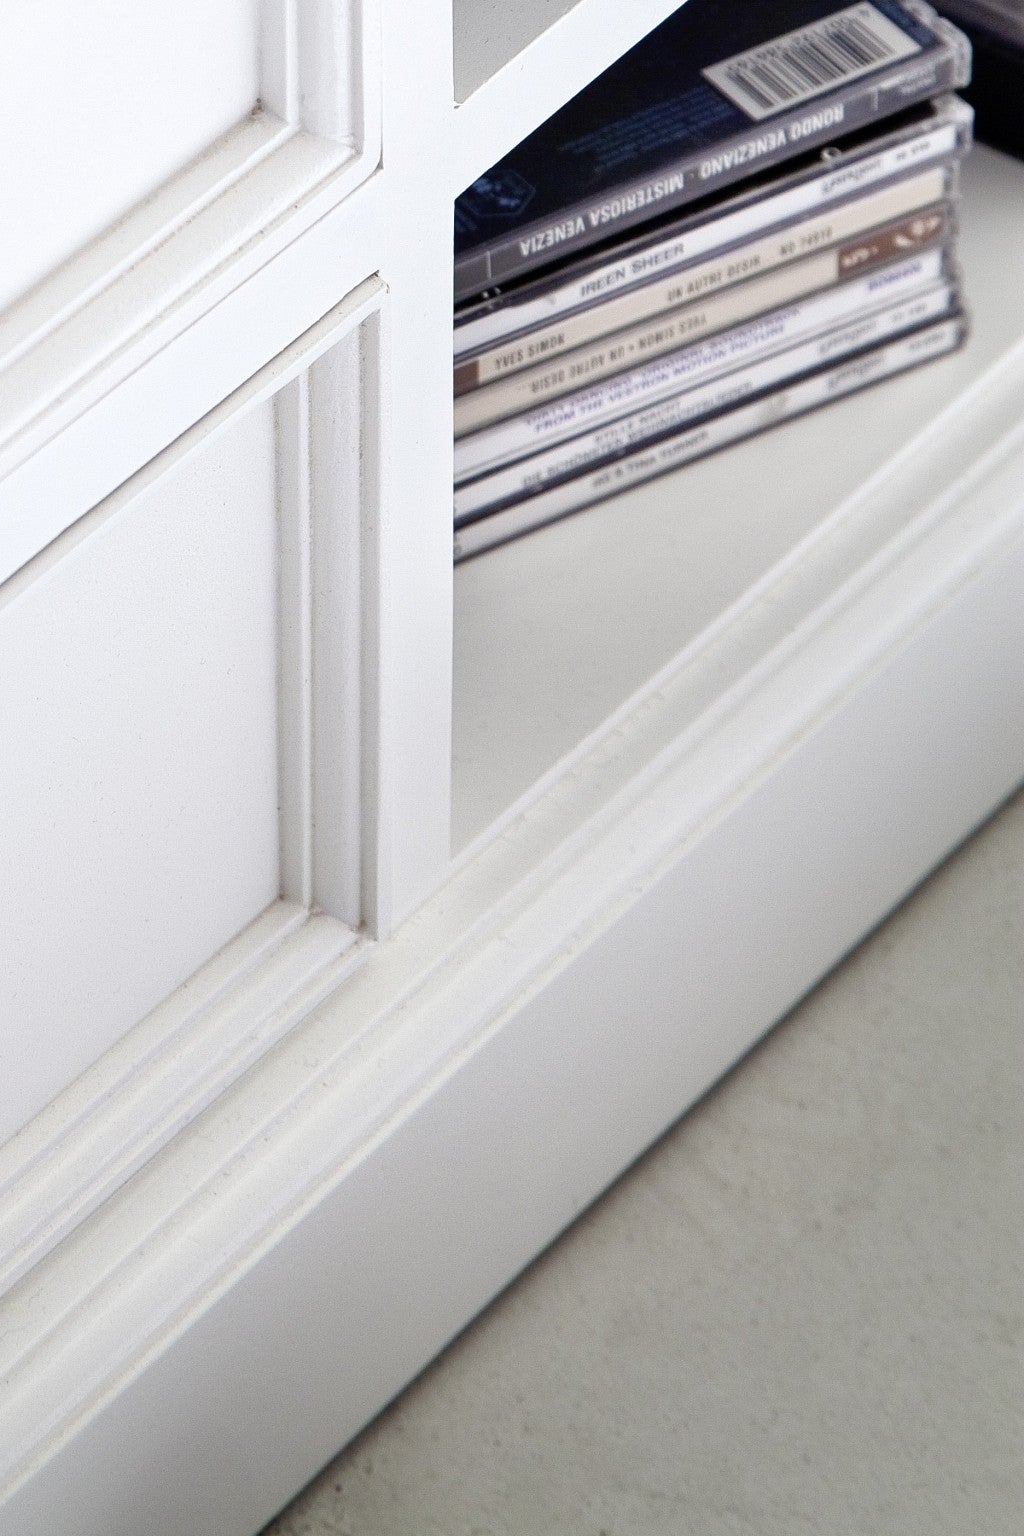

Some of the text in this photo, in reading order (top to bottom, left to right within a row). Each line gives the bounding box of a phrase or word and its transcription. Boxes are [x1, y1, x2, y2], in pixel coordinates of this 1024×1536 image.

[791, 103, 845, 141] RONDO
[700, 136, 788, 180] VENEZIANO
[590, 172, 685, 228] MISTERIOSA
[519, 223, 587, 257] VENEZIA
[630, 242, 686, 275] SHEER
